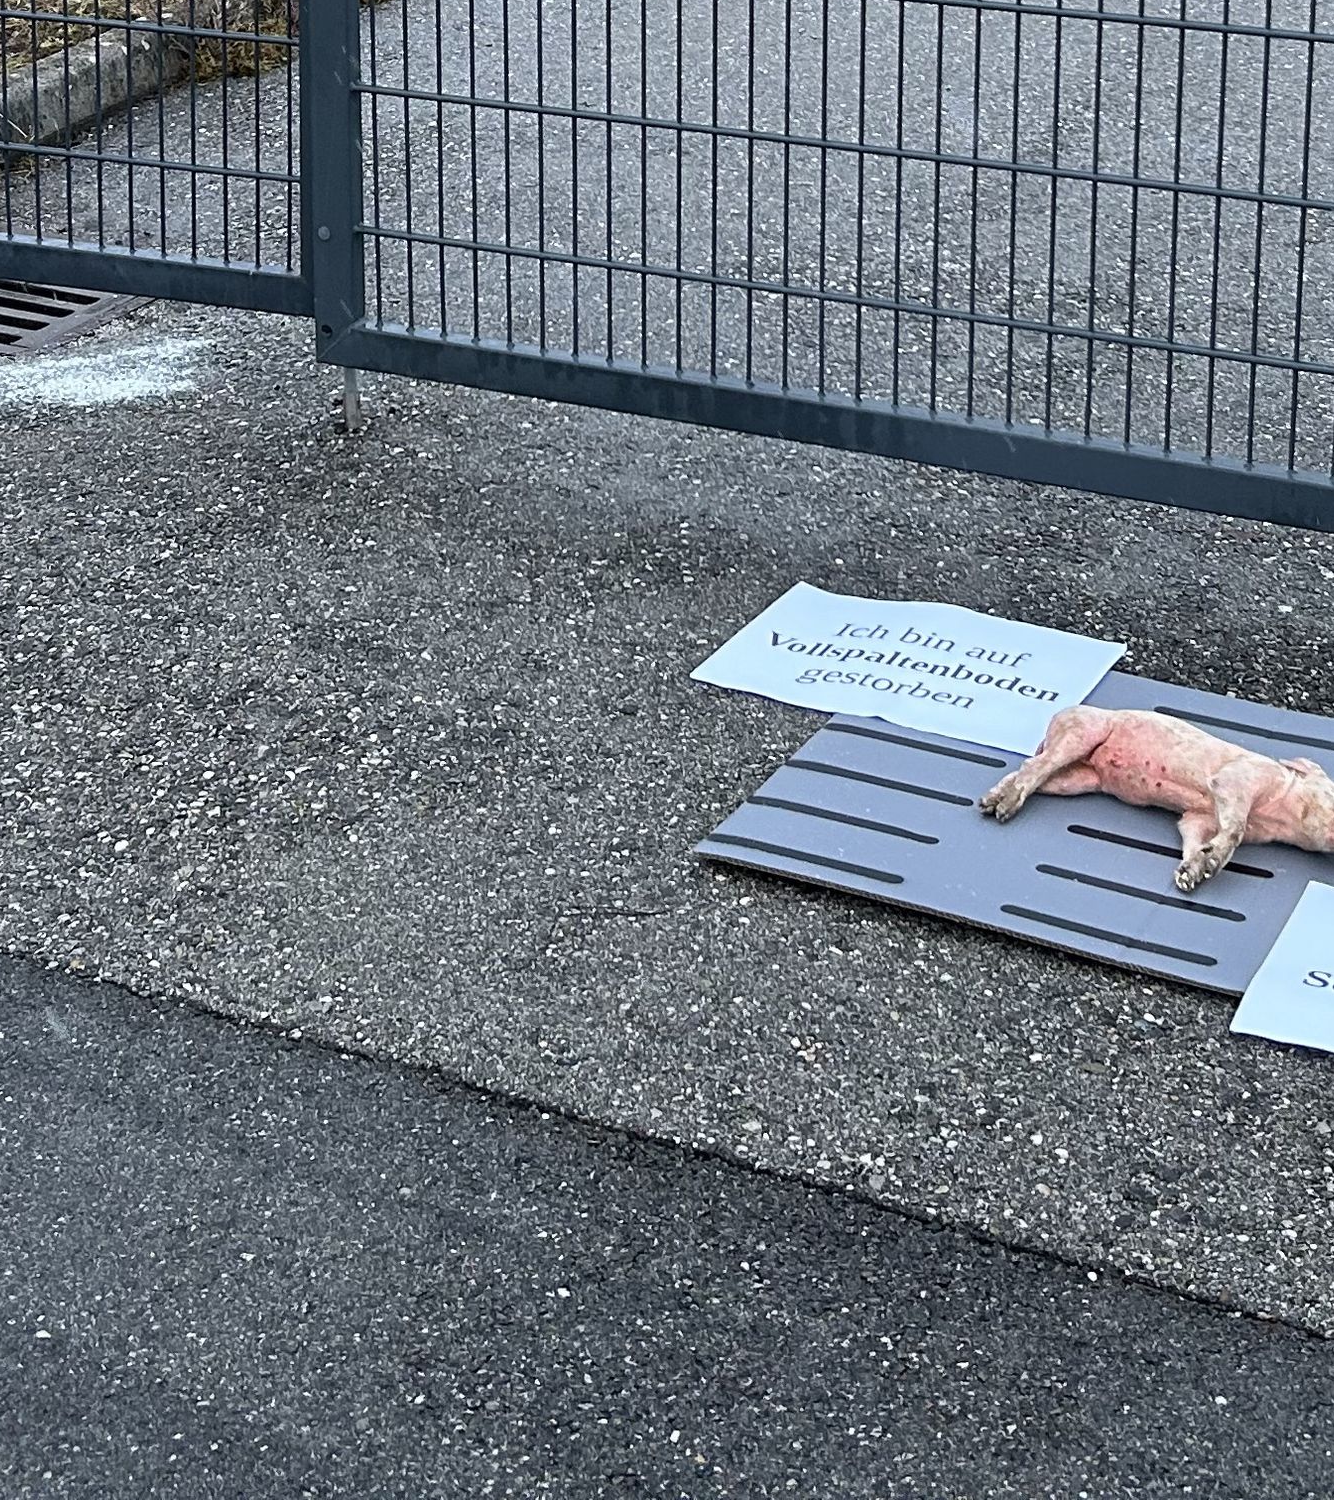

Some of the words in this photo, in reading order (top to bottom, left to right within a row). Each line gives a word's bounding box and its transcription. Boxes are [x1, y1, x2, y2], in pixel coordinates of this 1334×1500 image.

[770, 630, 1060, 703] Vollspaltenboden
[834, 622, 888, 641] Ich
[899, 626, 955, 652] bin
[966, 643, 1033, 669] auf
[795, 667, 975, 710] gestorben
